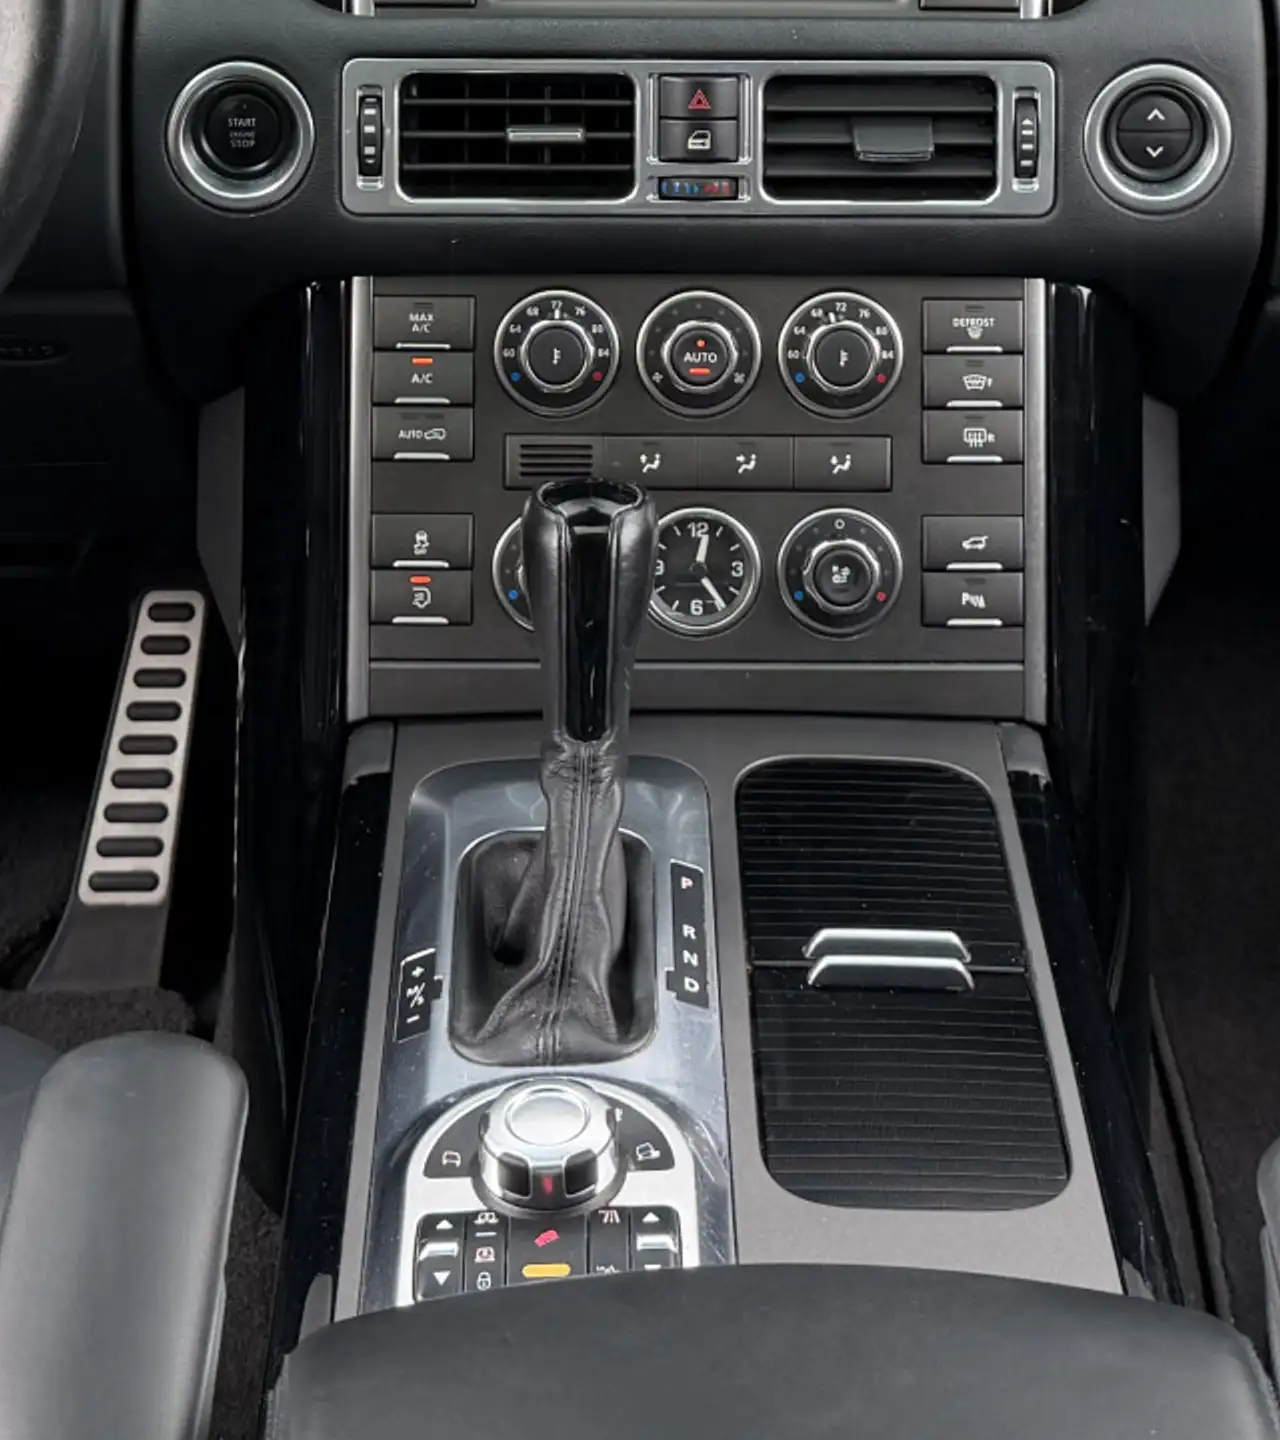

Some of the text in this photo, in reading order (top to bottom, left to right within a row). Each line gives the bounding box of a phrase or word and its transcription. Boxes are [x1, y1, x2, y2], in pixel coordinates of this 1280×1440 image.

[227, 117, 256, 127] START
[835, 302, 847, 312] 72
[409, 313, 434, 321] MAX
[858, 308, 871, 319] 76
[952, 317, 995, 327] DEFROST
[412, 323, 431, 333] A/C
[683, 352, 717, 363] AUTO
[410, 373, 433, 384] A/C
[398, 430, 423, 439] AUTO
[687, 522, 709, 538] 12
[731, 561, 743, 577] 3
[690, 598, 703, 615] 6
[680, 876, 693, 889] P
[682, 924, 696, 940] R
[683, 951, 698, 966] N
[684, 977, 699, 992] D
